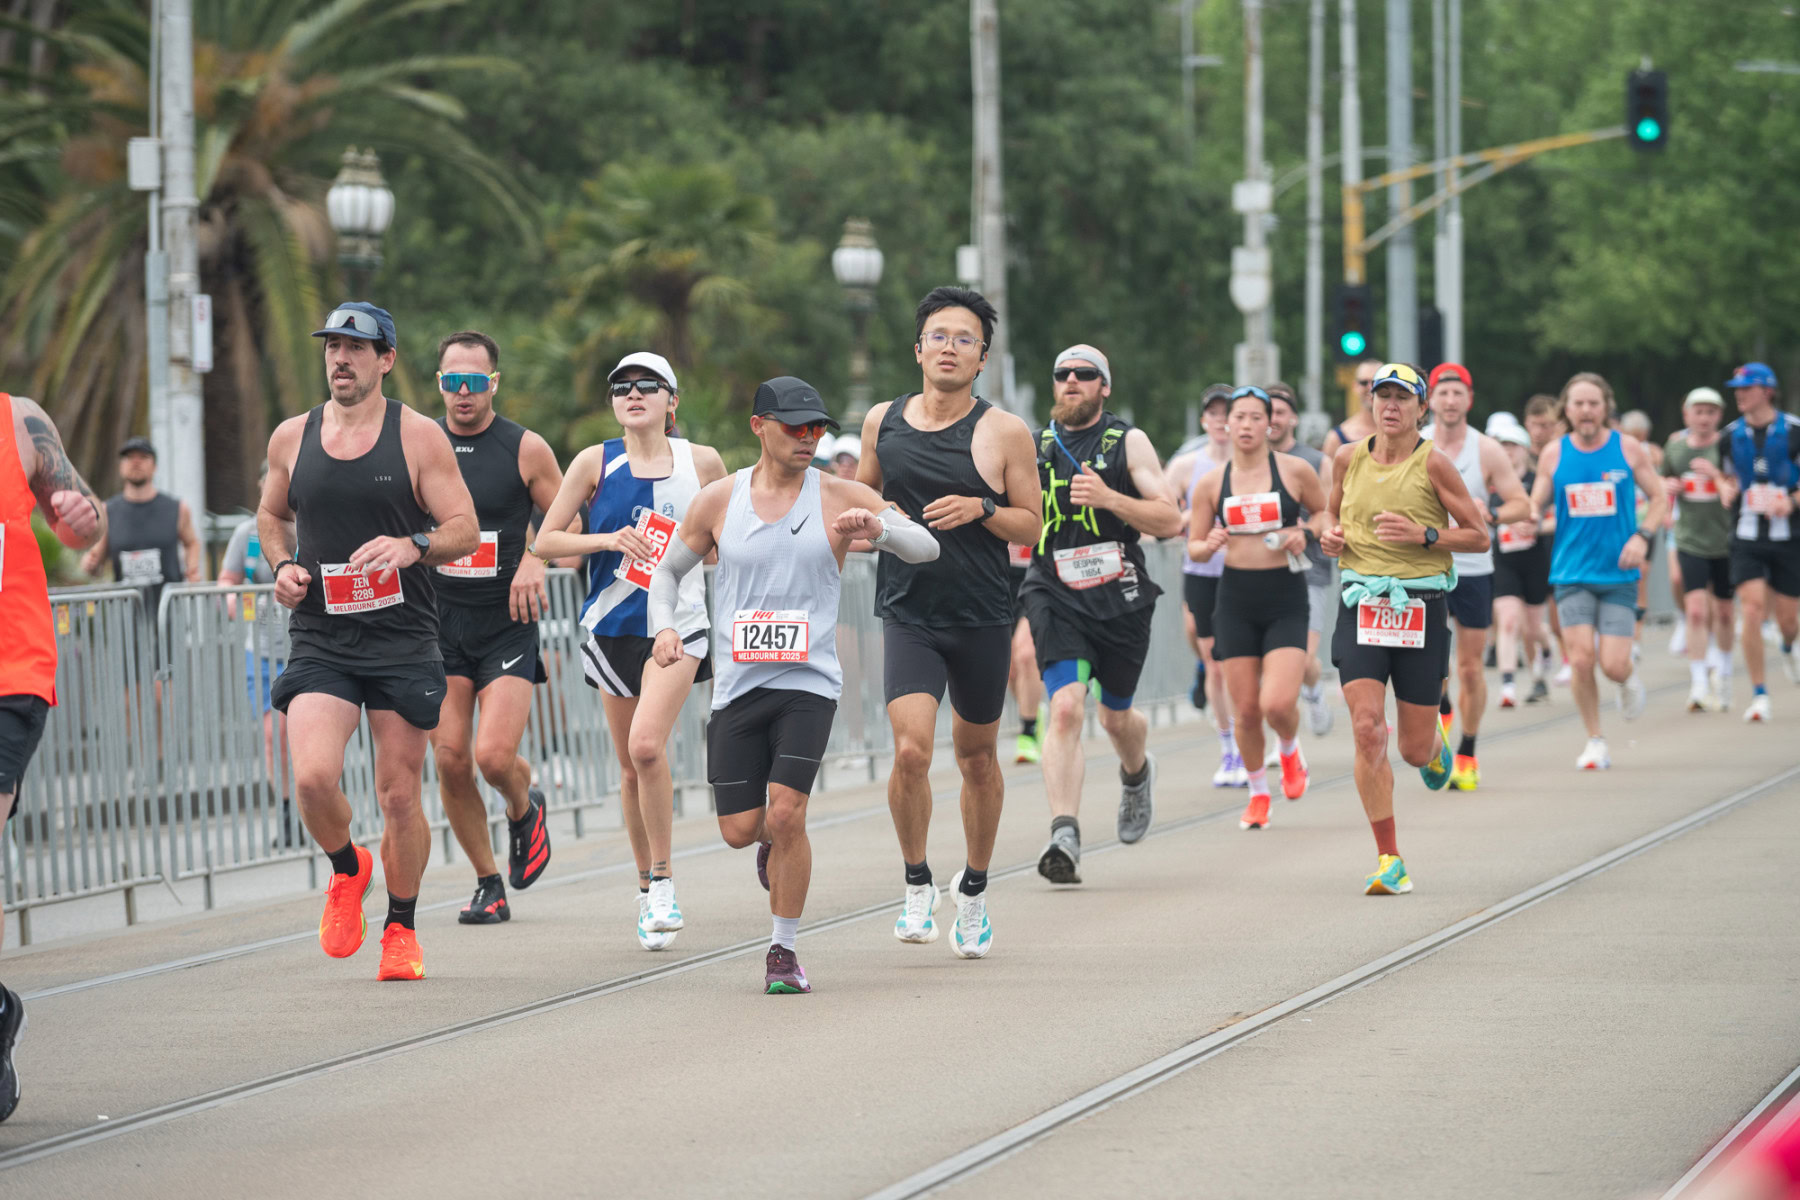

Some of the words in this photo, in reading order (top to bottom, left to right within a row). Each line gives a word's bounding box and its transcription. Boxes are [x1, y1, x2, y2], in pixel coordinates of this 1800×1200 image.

[632, 526, 669, 576] 9518
[352, 576, 370, 589] ZEN
[352, 587, 375, 601] 3289
[333, 601, 377, 613] MELBOURNE
[378, 596, 397, 607] 2025
[1370, 607, 1414, 630] 7807
[741, 624, 799, 650] 12457
[1363, 630, 1400, 638] MELBOURNE
[738, 651, 779, 660] MELBOURNE
[780, 652, 801, 660] 2025
